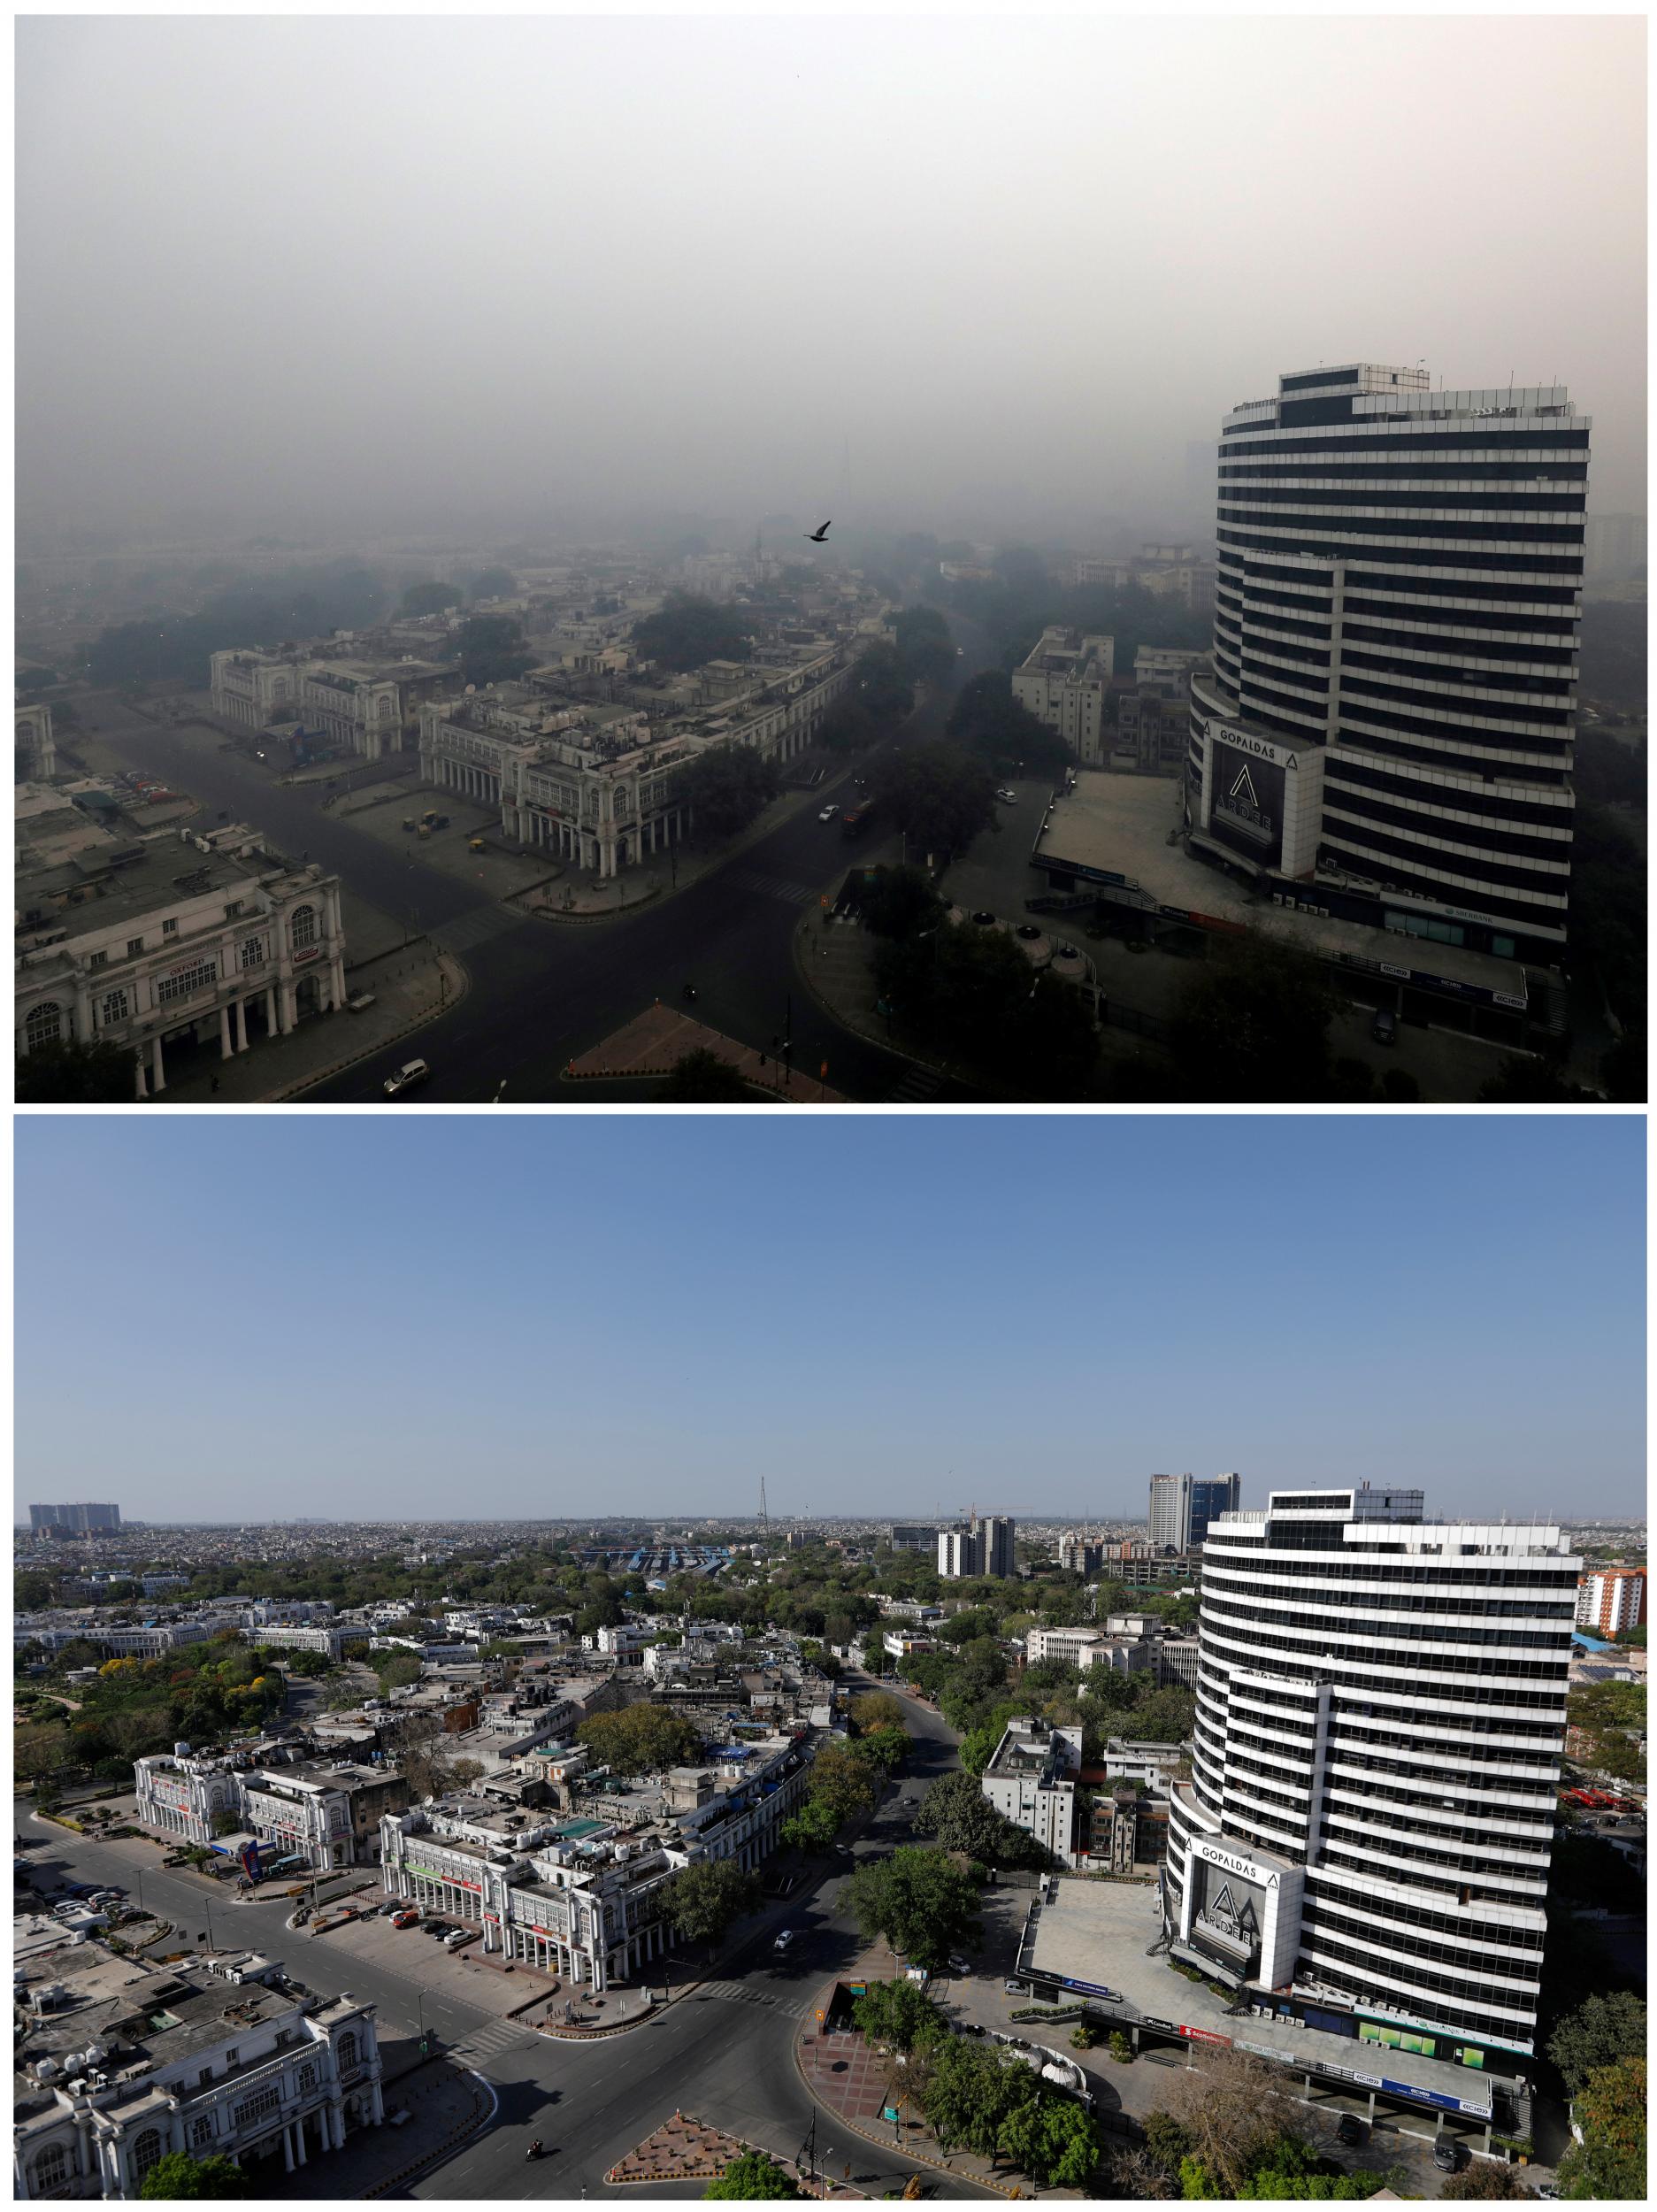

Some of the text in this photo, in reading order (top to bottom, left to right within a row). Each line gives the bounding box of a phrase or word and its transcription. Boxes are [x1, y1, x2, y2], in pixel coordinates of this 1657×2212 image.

[1220, 730, 1275, 759] GOPALDAS
[1216, 794, 1272, 832] ARDEE
[170, 957, 204, 977] OXFORD
[1202, 1847, 1256, 1878] GOPALDAS
[1196, 1909, 1251, 1947] ARDEE
[242, 2084, 270, 2101] OXFORD
